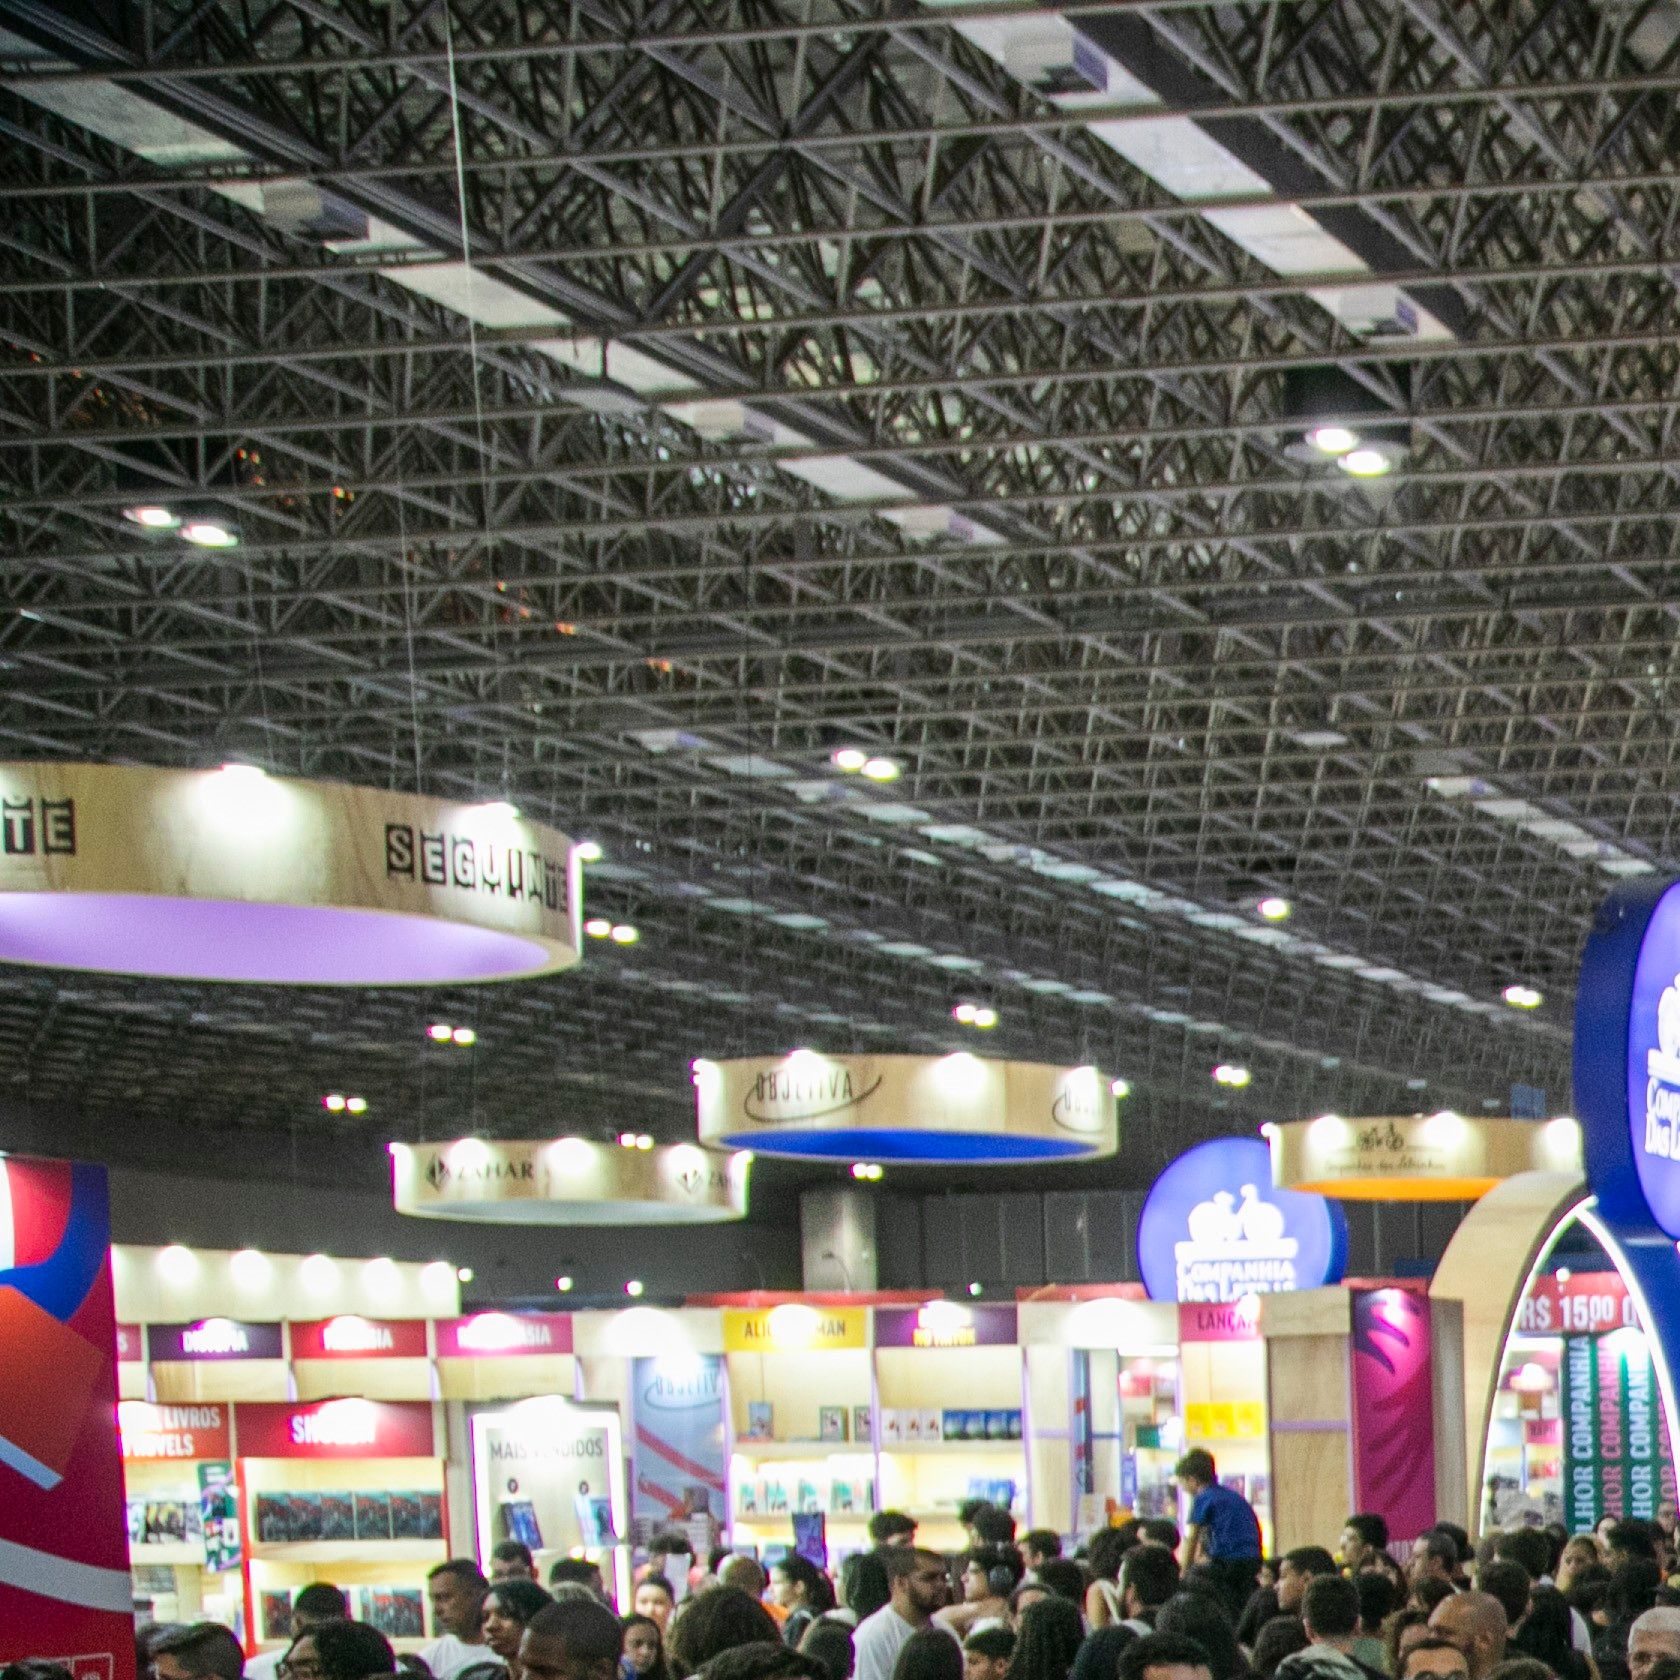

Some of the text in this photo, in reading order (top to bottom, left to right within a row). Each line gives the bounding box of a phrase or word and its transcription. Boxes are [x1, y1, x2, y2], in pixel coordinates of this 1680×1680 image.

[385, 823, 570, 913] SEGUINTE
[1645, 1112, 1670, 1158] DAS
[1177, 1260, 1295, 1283] COMPANHIA
[165, 1406, 220, 1430] LIVROS
[1569, 1336, 1594, 1460] COMPANHIA
[1573, 1466, 1594, 1534] LHOR
